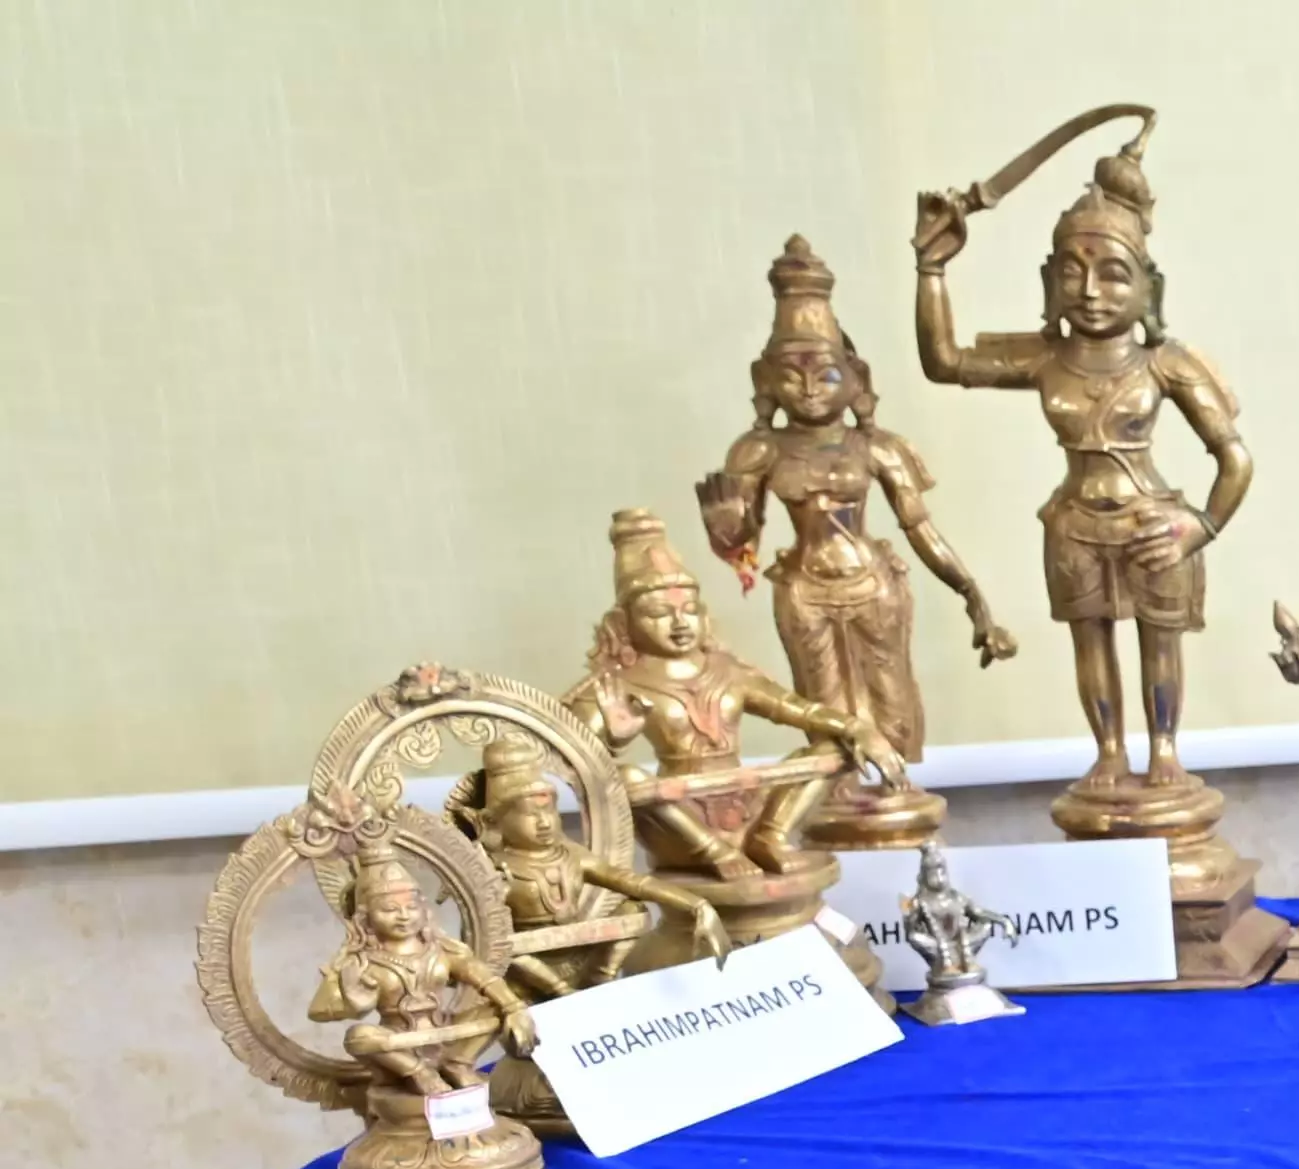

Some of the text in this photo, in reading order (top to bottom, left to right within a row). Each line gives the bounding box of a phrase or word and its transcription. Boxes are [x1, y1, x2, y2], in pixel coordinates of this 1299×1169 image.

[1084, 906, 1120, 930] PS
[571, 974, 823, 1068] IBRAHIMPATNAM PS
